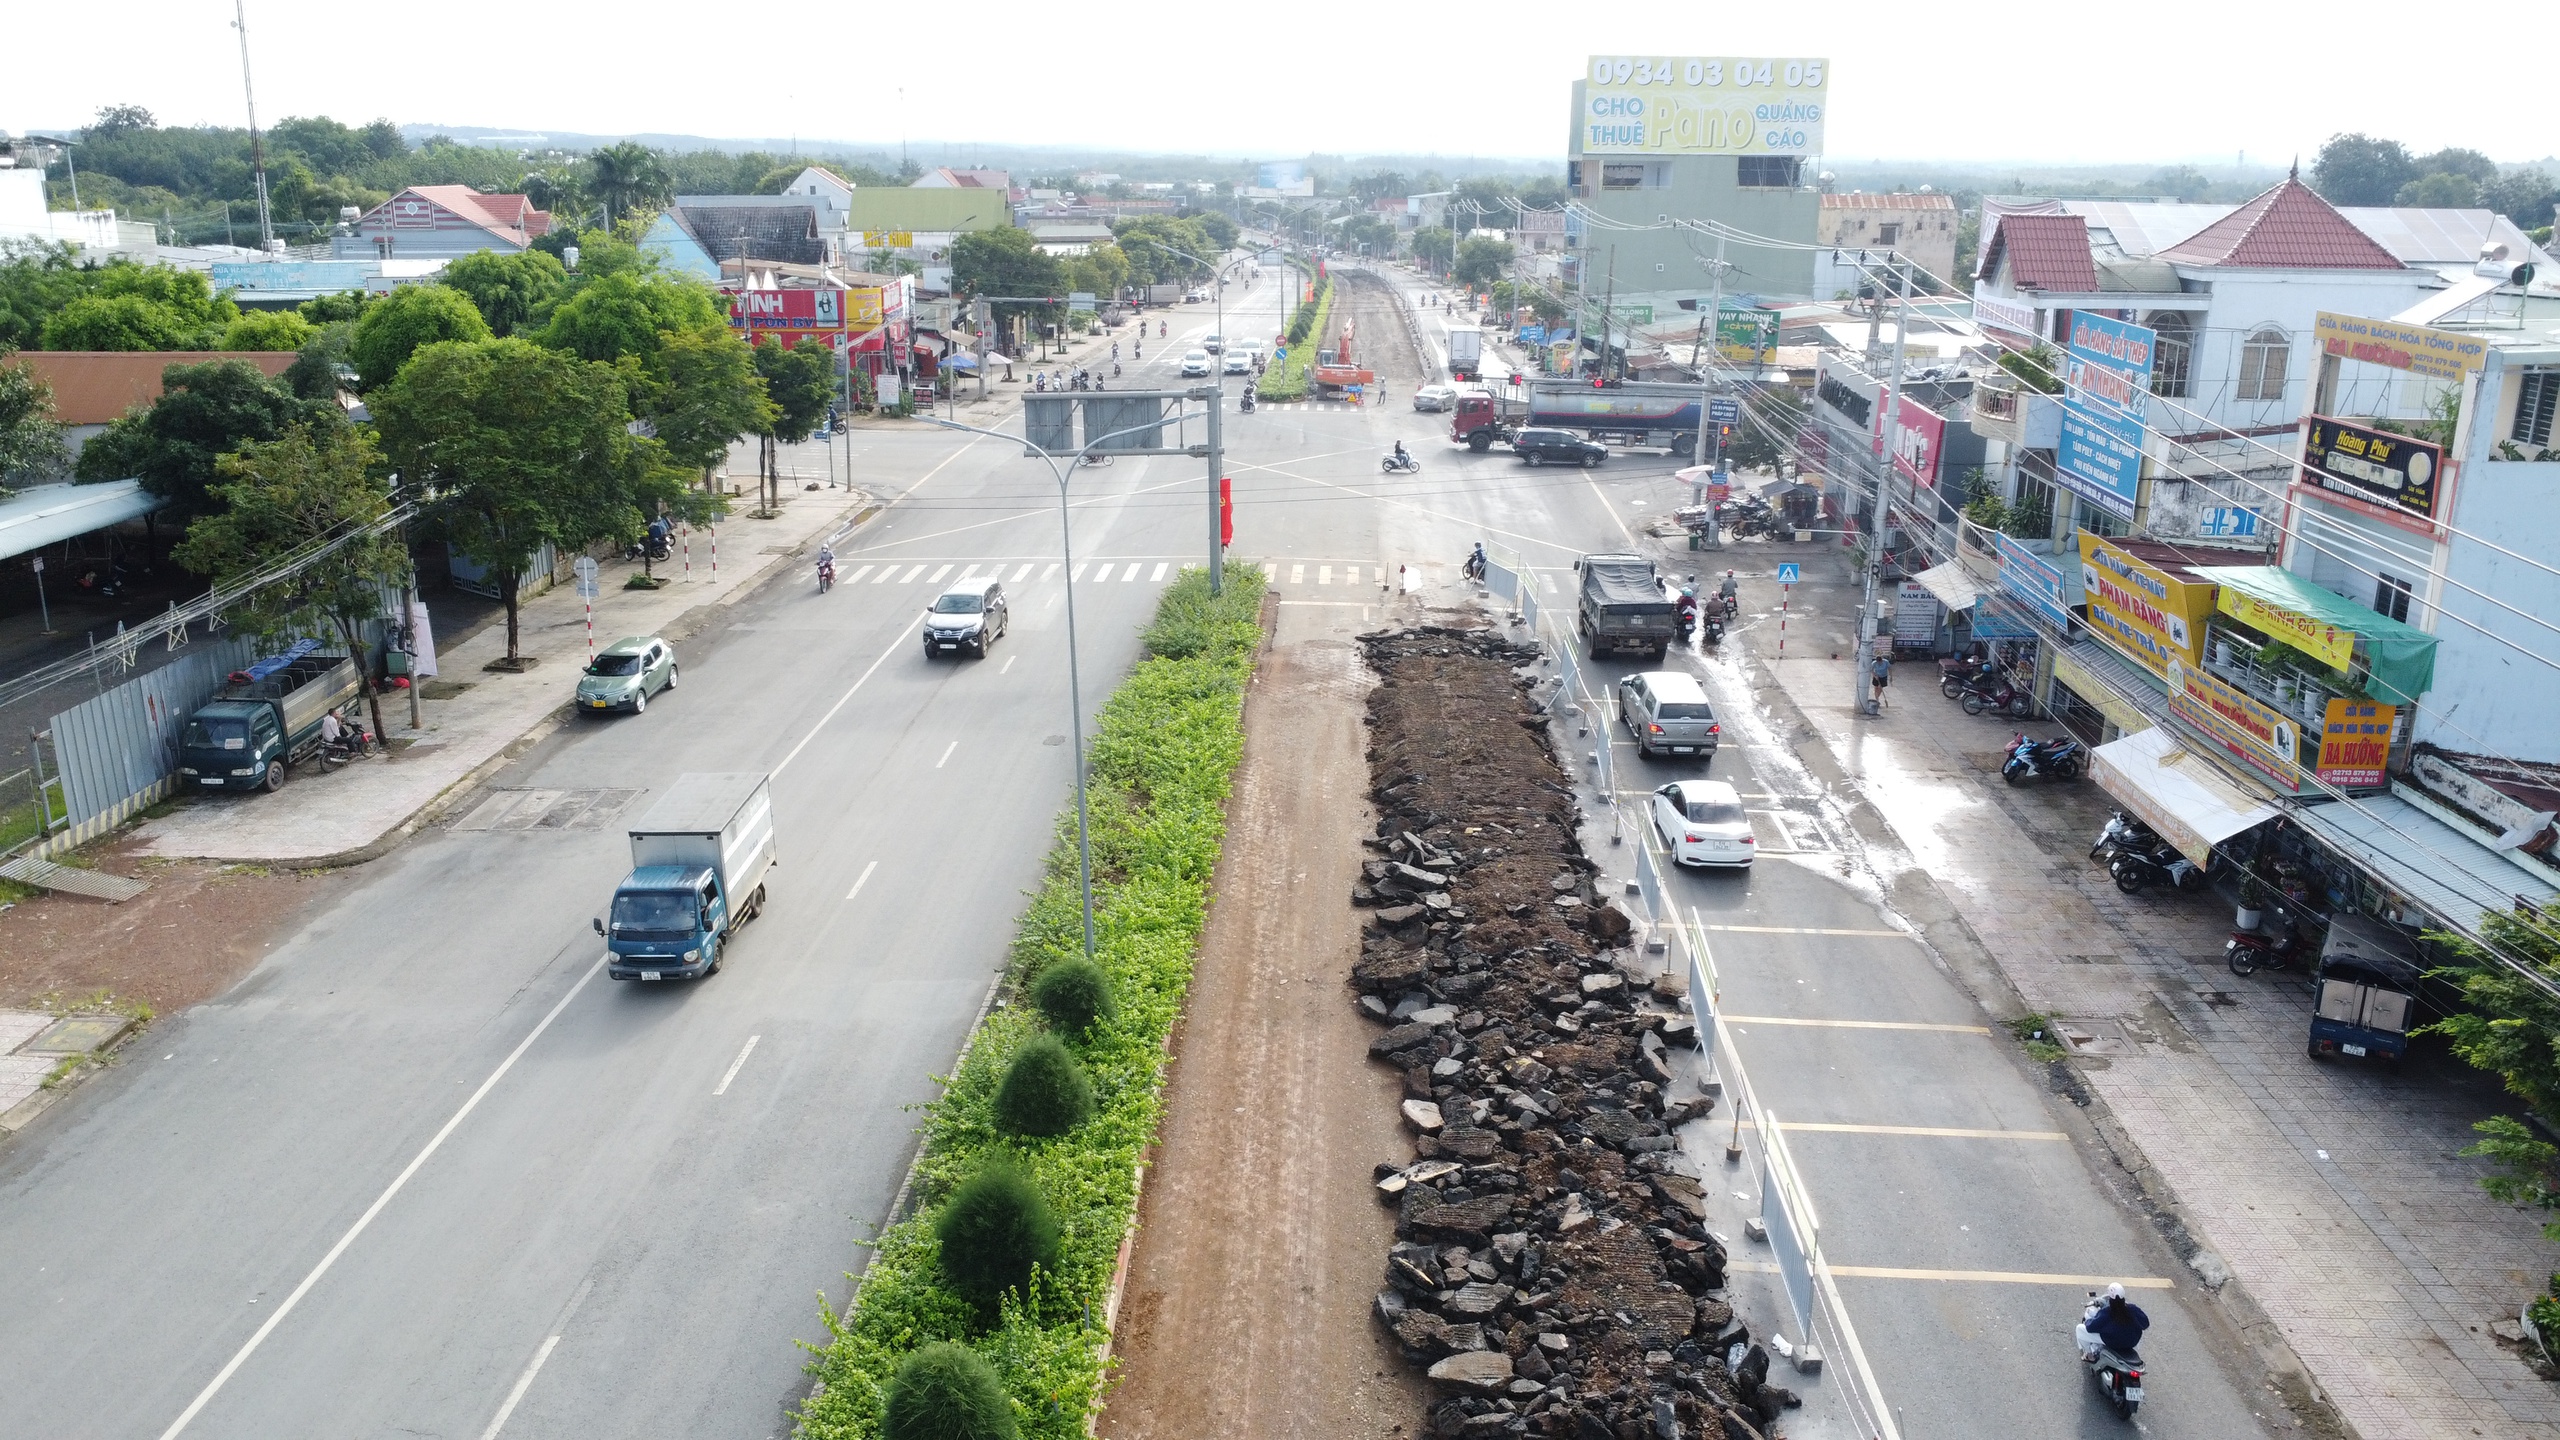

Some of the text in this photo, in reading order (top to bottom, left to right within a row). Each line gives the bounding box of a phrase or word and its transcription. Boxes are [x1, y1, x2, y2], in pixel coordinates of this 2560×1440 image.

[1593, 59, 1823, 87] 0934 03 04 05
[1592, 97, 1645, 116] CHO
[1755, 99, 1821, 122] QUẢNG
[1591, 121, 1644, 145] THUÊ
[1651, 96, 1755, 147] Pano
[1766, 127, 1806, 149] CÁO
[1718, 312, 1773, 322] VAY NHANH
[2089, 325, 2113, 356] HÀNG
[2111, 326, 2128, 360] SẮT
[2127, 336, 2149, 367] THÉP
[2319, 315, 2337, 329] CỬA
[2371, 324, 2397, 341] BÁCH
[2399, 330, 2420, 345] HÓA
[2425, 333, 2454, 351] TỔNG
[2457, 343, 2482, 358] HỢP
[2337, 430, 2366, 455] Hoàng
[2135, 570, 2148, 589] XE
[2147, 577, 2167, 600] MÁY
[2099, 576, 2133, 613] PHẠM
[2132, 592, 2169, 634] BẰNG
[2093, 603, 2116, 629] BÁN
[2116, 617, 2133, 639] XE
[2133, 628, 2158, 655] TRẢ
[2324, 742, 2340, 765] BA
